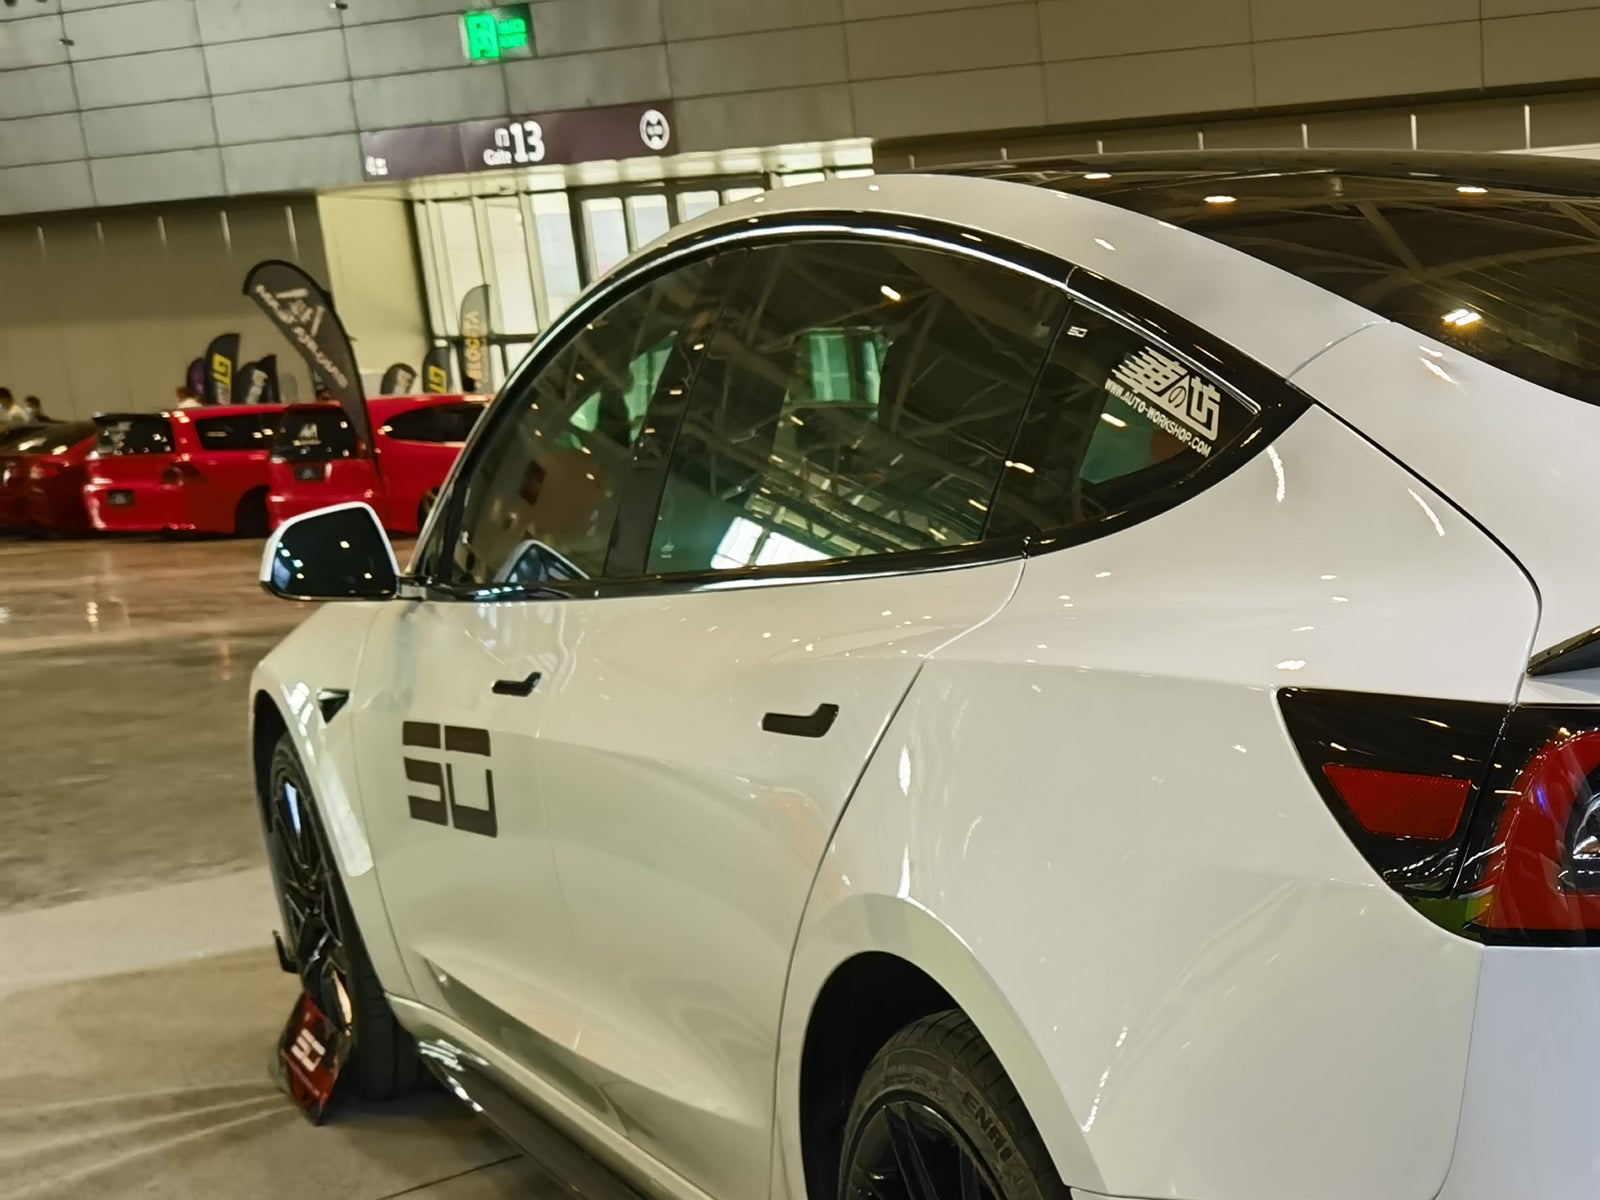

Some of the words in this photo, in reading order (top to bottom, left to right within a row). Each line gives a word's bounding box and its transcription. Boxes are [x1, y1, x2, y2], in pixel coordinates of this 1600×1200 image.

[510, 121, 545, 163] 13
[1104, 378, 1212, 458] WWW.AUTO-WORKSHOP.COM
[402, 720, 498, 838] SD
